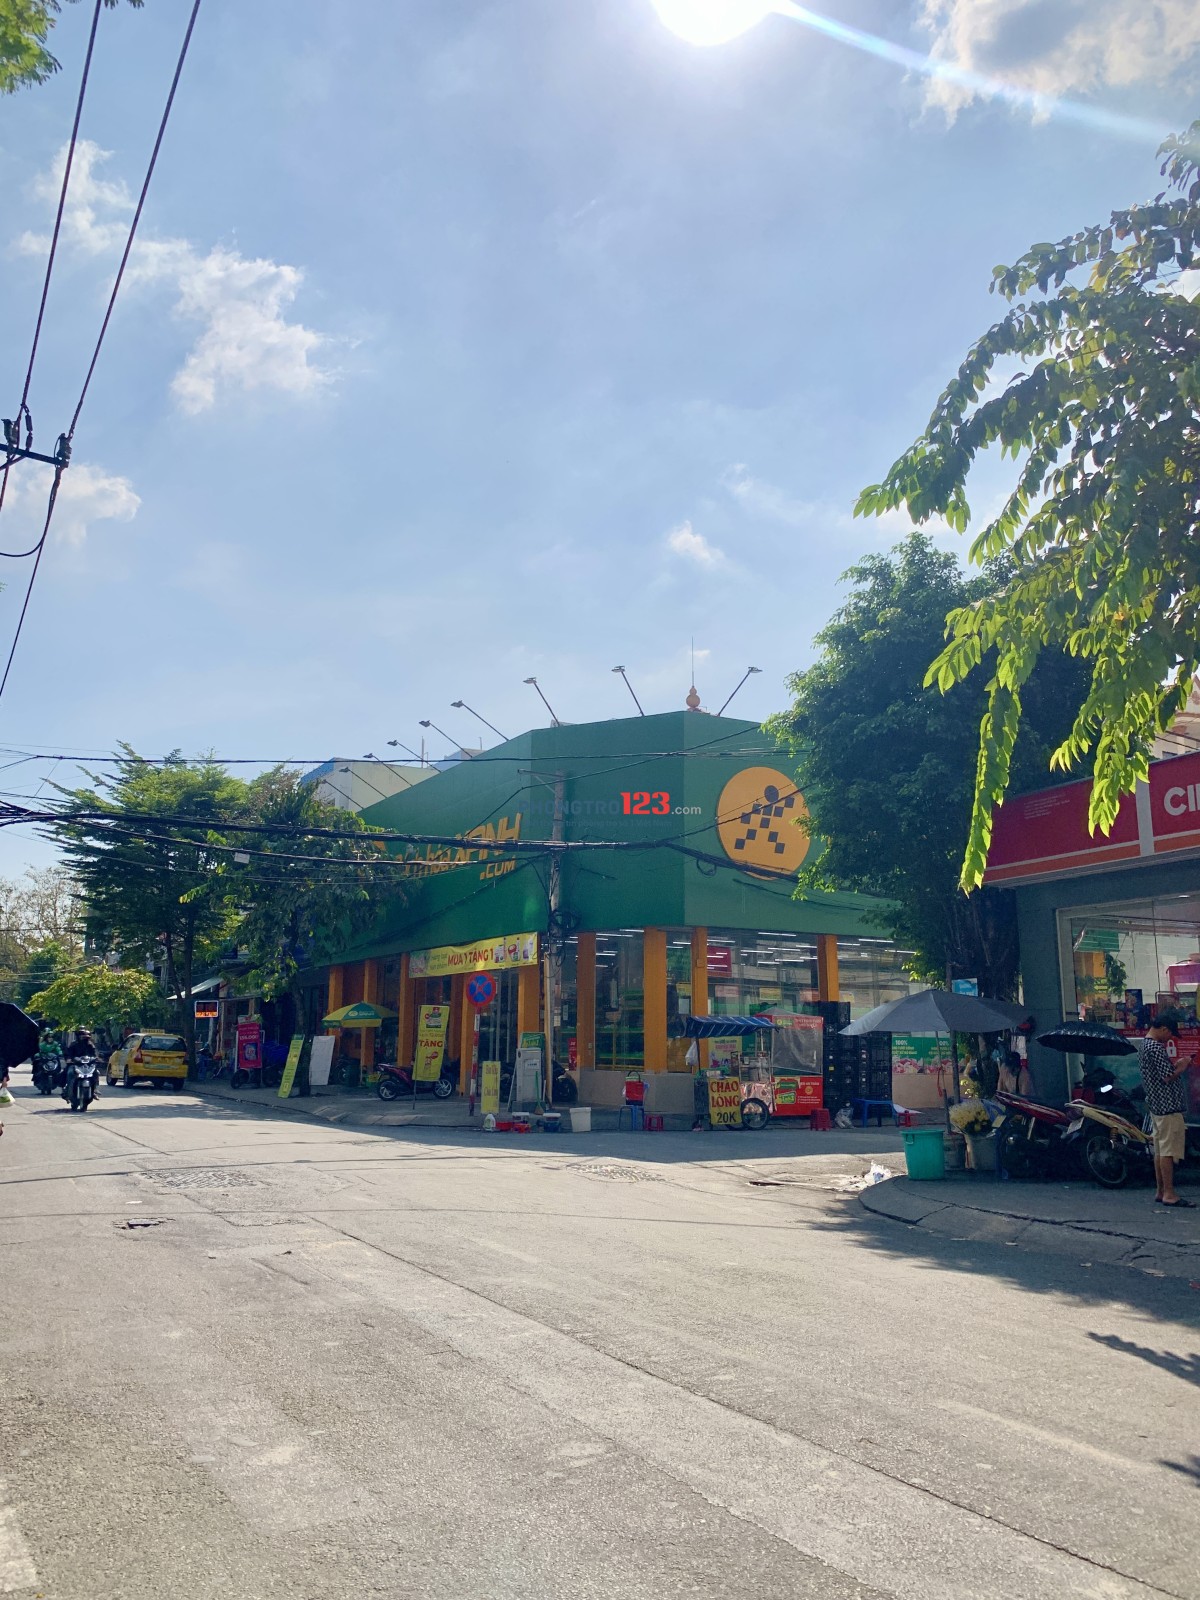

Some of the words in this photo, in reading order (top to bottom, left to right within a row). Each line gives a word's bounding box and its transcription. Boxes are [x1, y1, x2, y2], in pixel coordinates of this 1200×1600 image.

[1163, 783, 1200, 817] CI
[447, 952, 463, 967] MUA
[716, 1111, 737, 1123] 20K
